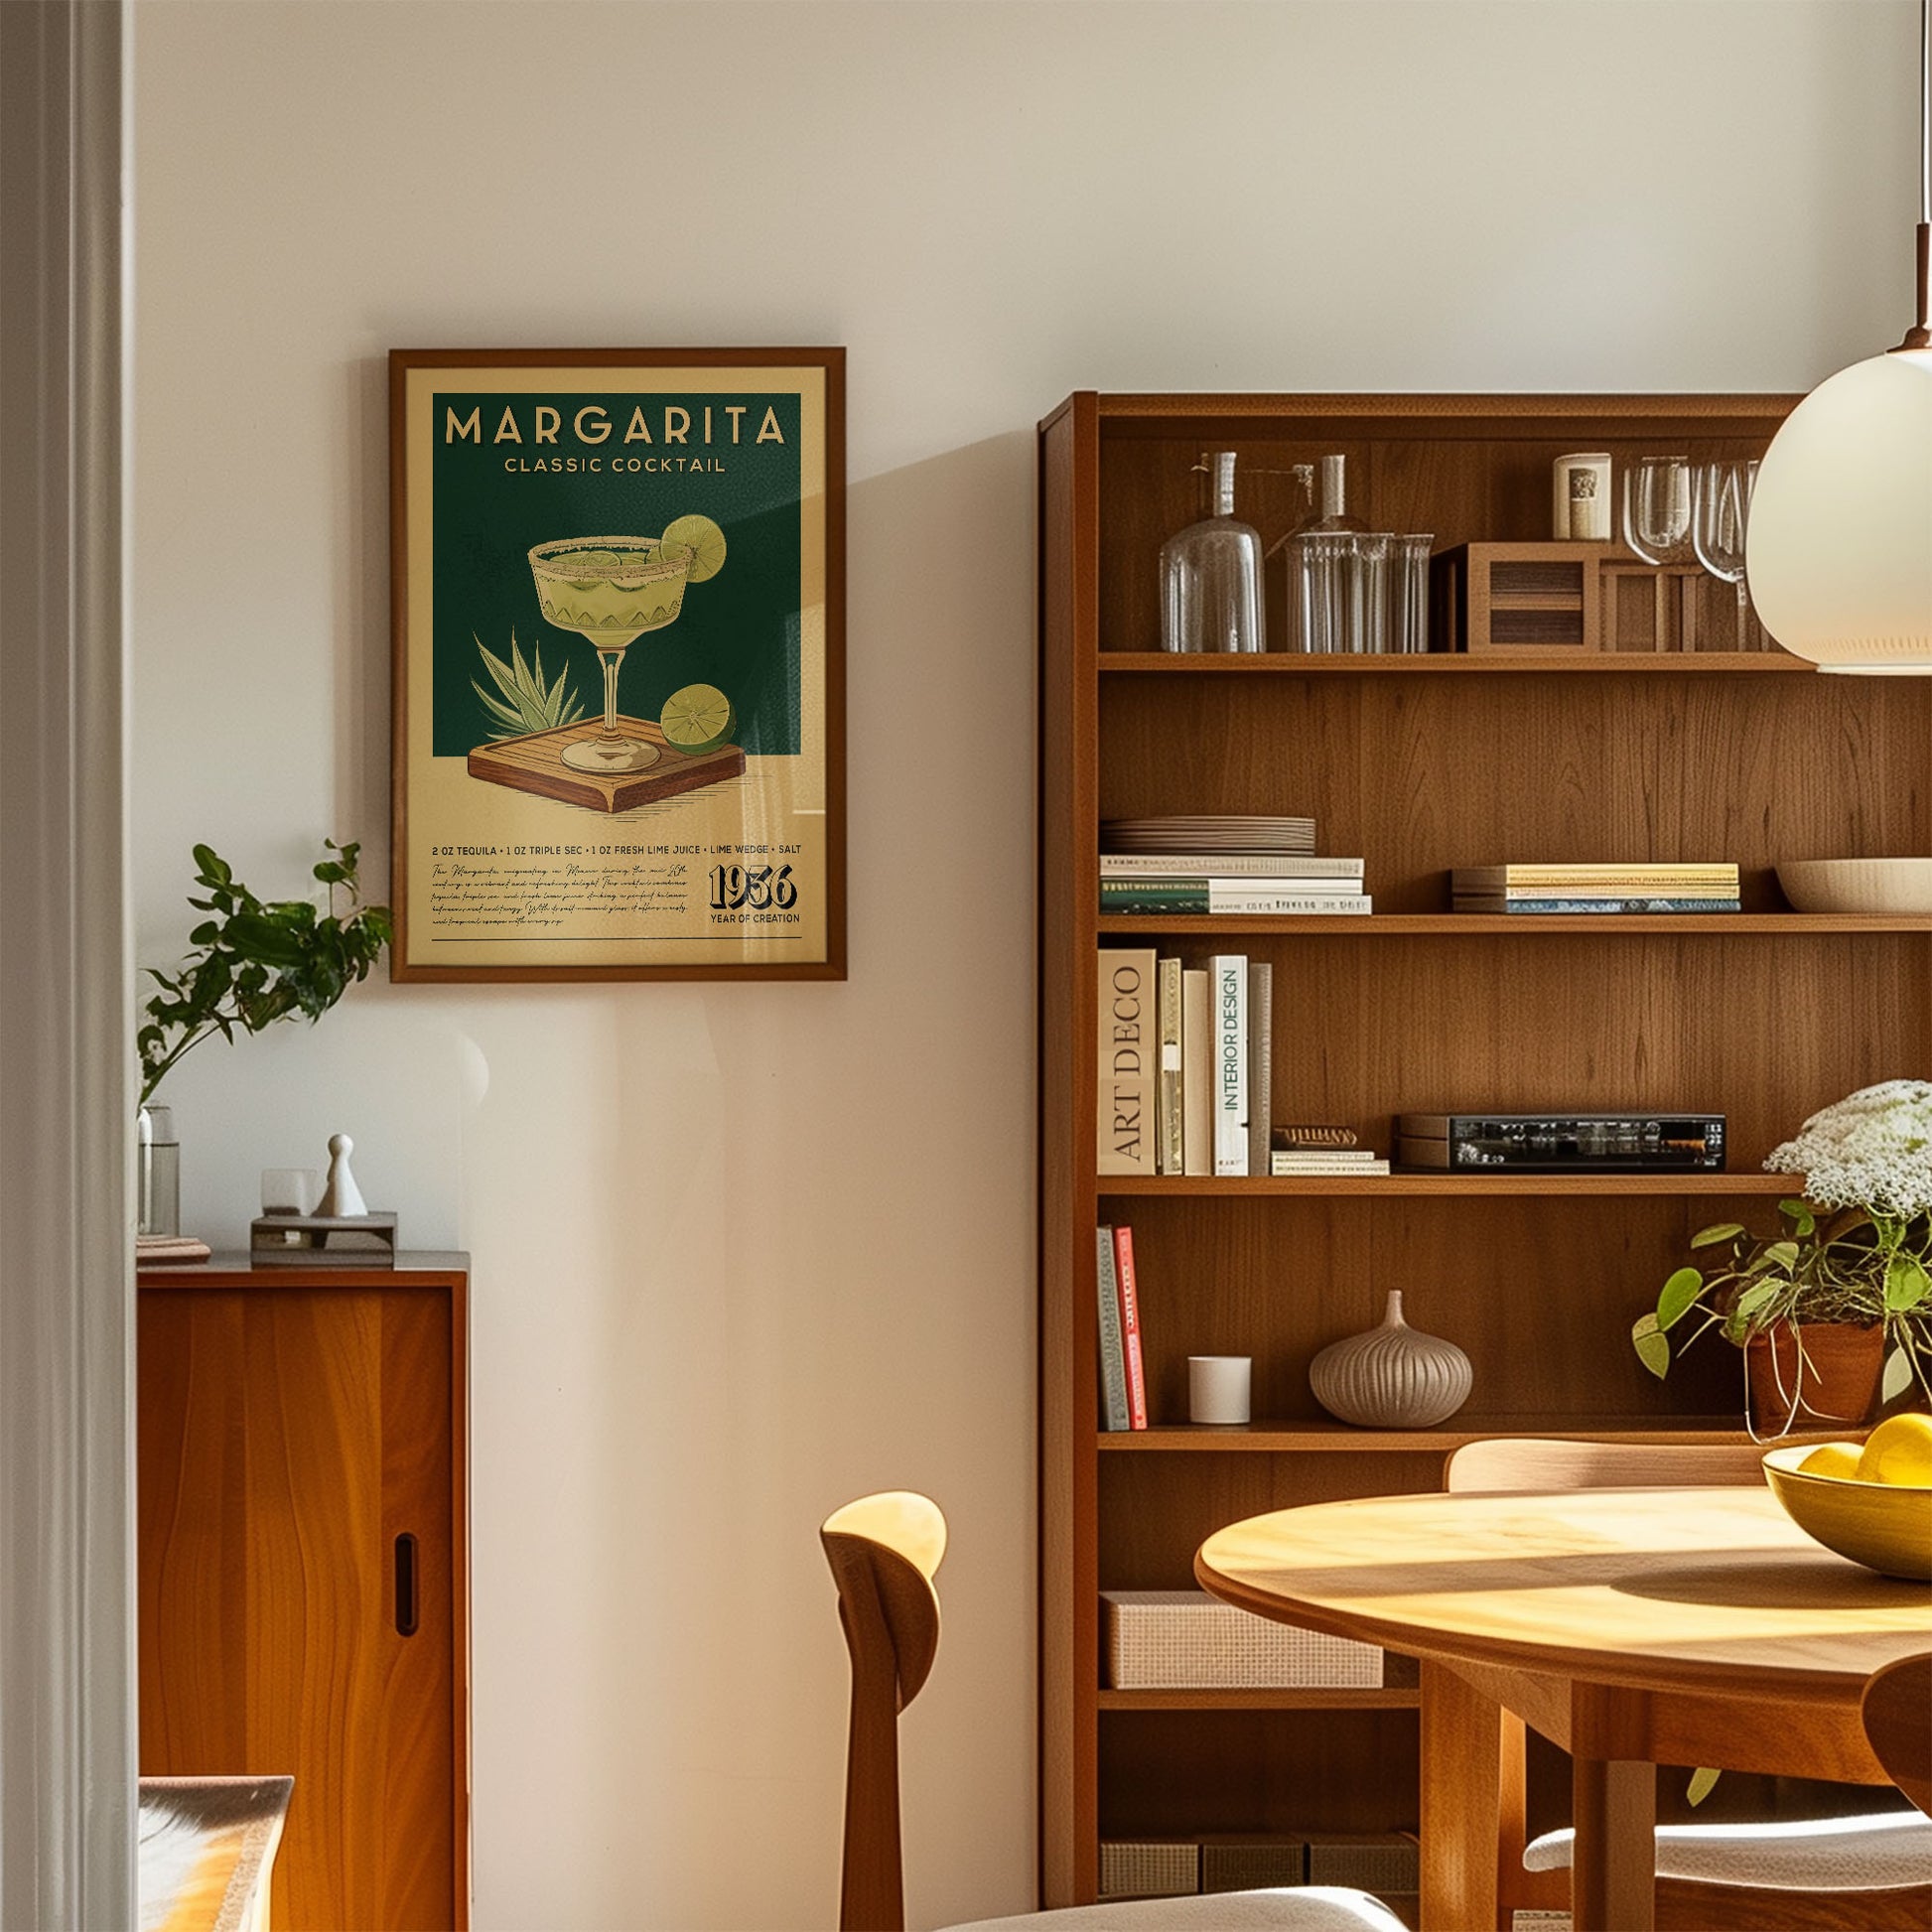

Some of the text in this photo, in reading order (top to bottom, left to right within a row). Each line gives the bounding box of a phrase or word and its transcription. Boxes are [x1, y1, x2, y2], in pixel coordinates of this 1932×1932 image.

[445, 406, 784, 445] MARGARITA
[504, 458, 726, 474] CLASSIC COCKTAIL
[432, 844, 802, 856] 2 OZ TEQUILA 1 OZ TRIPLE SEC 1 OZ FRESH LIME JUICE LIME WEDGE SALT
[708, 864, 798, 910] 1936
[710, 913, 800, 923] YEAR OF CREATION
[1222, 969, 1238, 1111] INTERIOR DESIGN
[1112, 966, 1141, 1162] ART DECO
